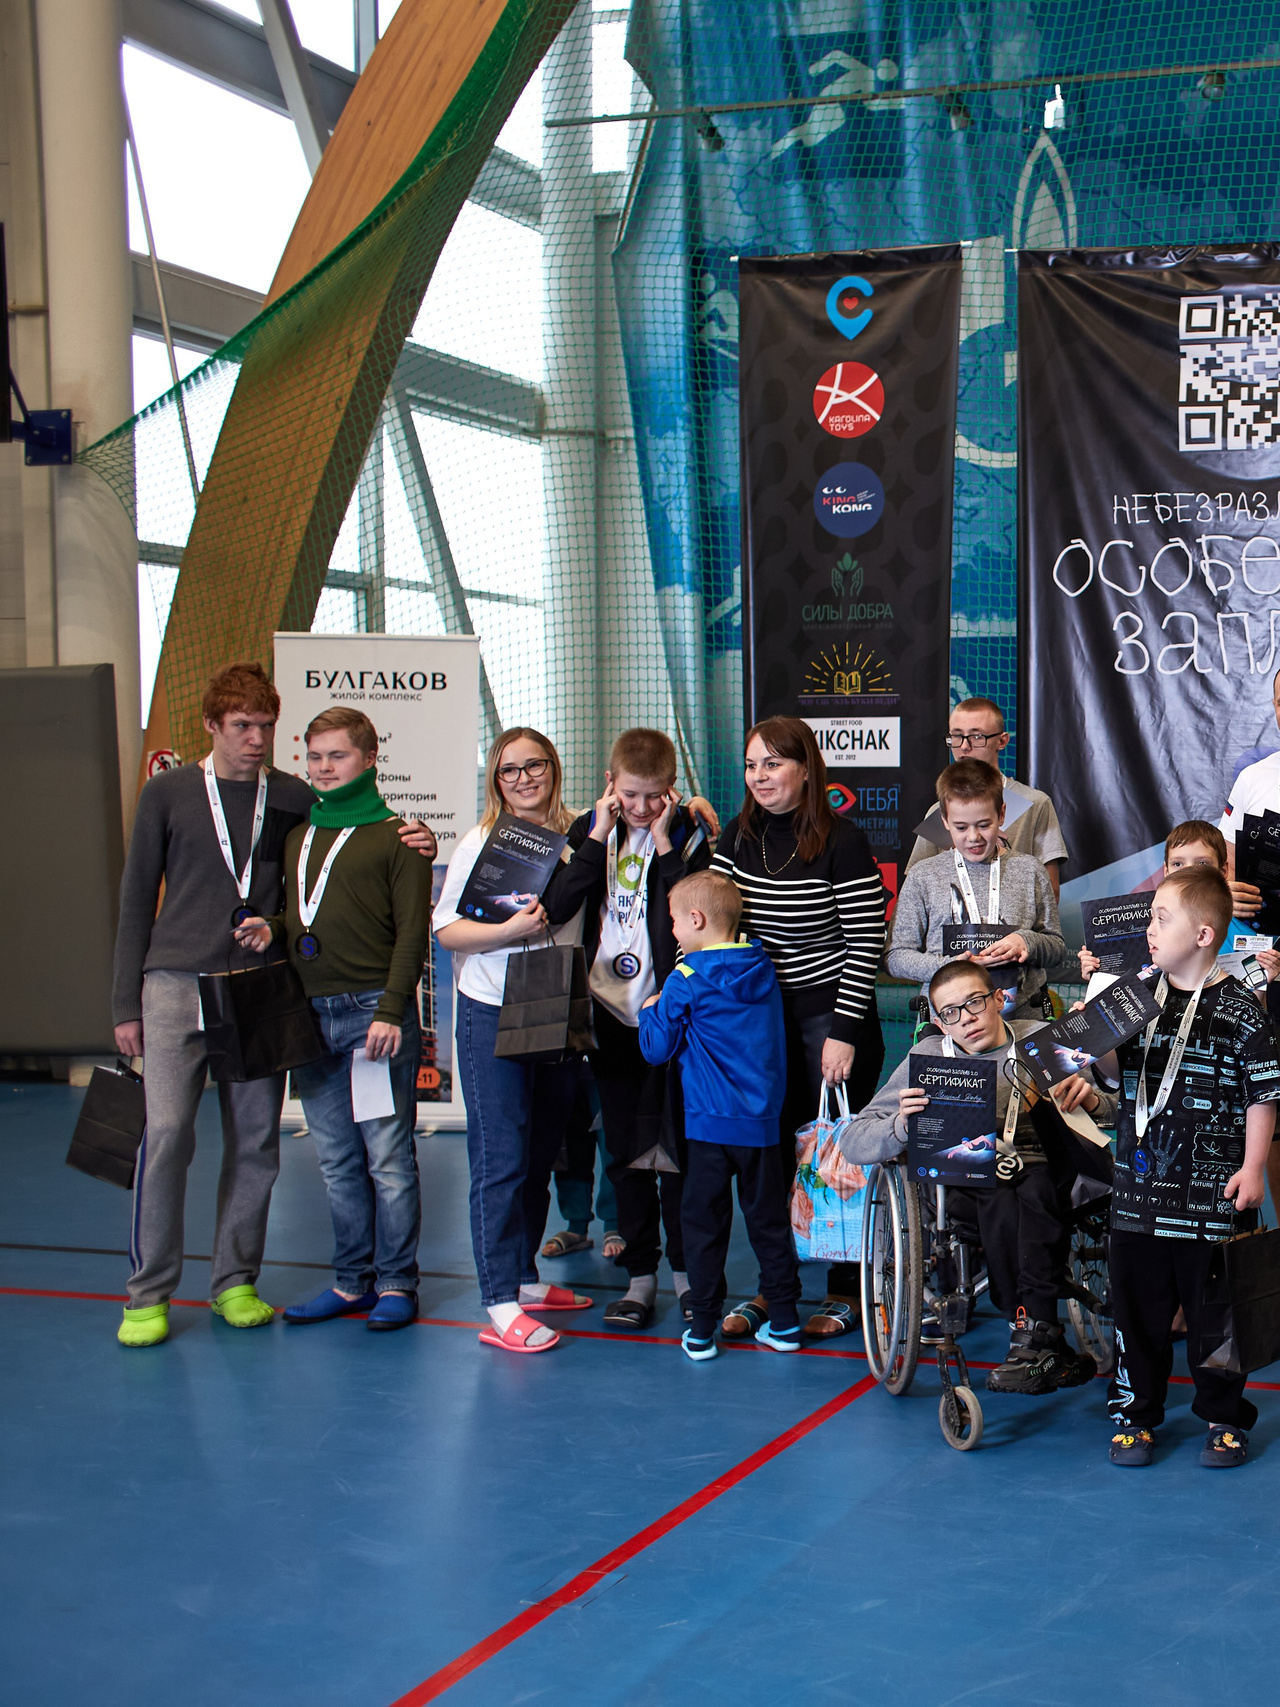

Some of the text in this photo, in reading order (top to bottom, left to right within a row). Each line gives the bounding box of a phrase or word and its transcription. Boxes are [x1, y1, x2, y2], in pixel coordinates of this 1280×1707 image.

[802, 603, 894, 622] СИЛЫ ДОБРА
[306, 670, 447, 691] БУЛГАКОВ
[330, 692, 423, 702] жилой комплекс
[857, 788, 898, 812] ТЕБЯ
[409, 812, 455, 822] паркинг
[498, 828, 554, 856] СЕРТИФИКАТ
[918, 1073, 987, 1089] СЕРТИФИКАТ
[1190, 1180, 1214, 1189] FUTURE
